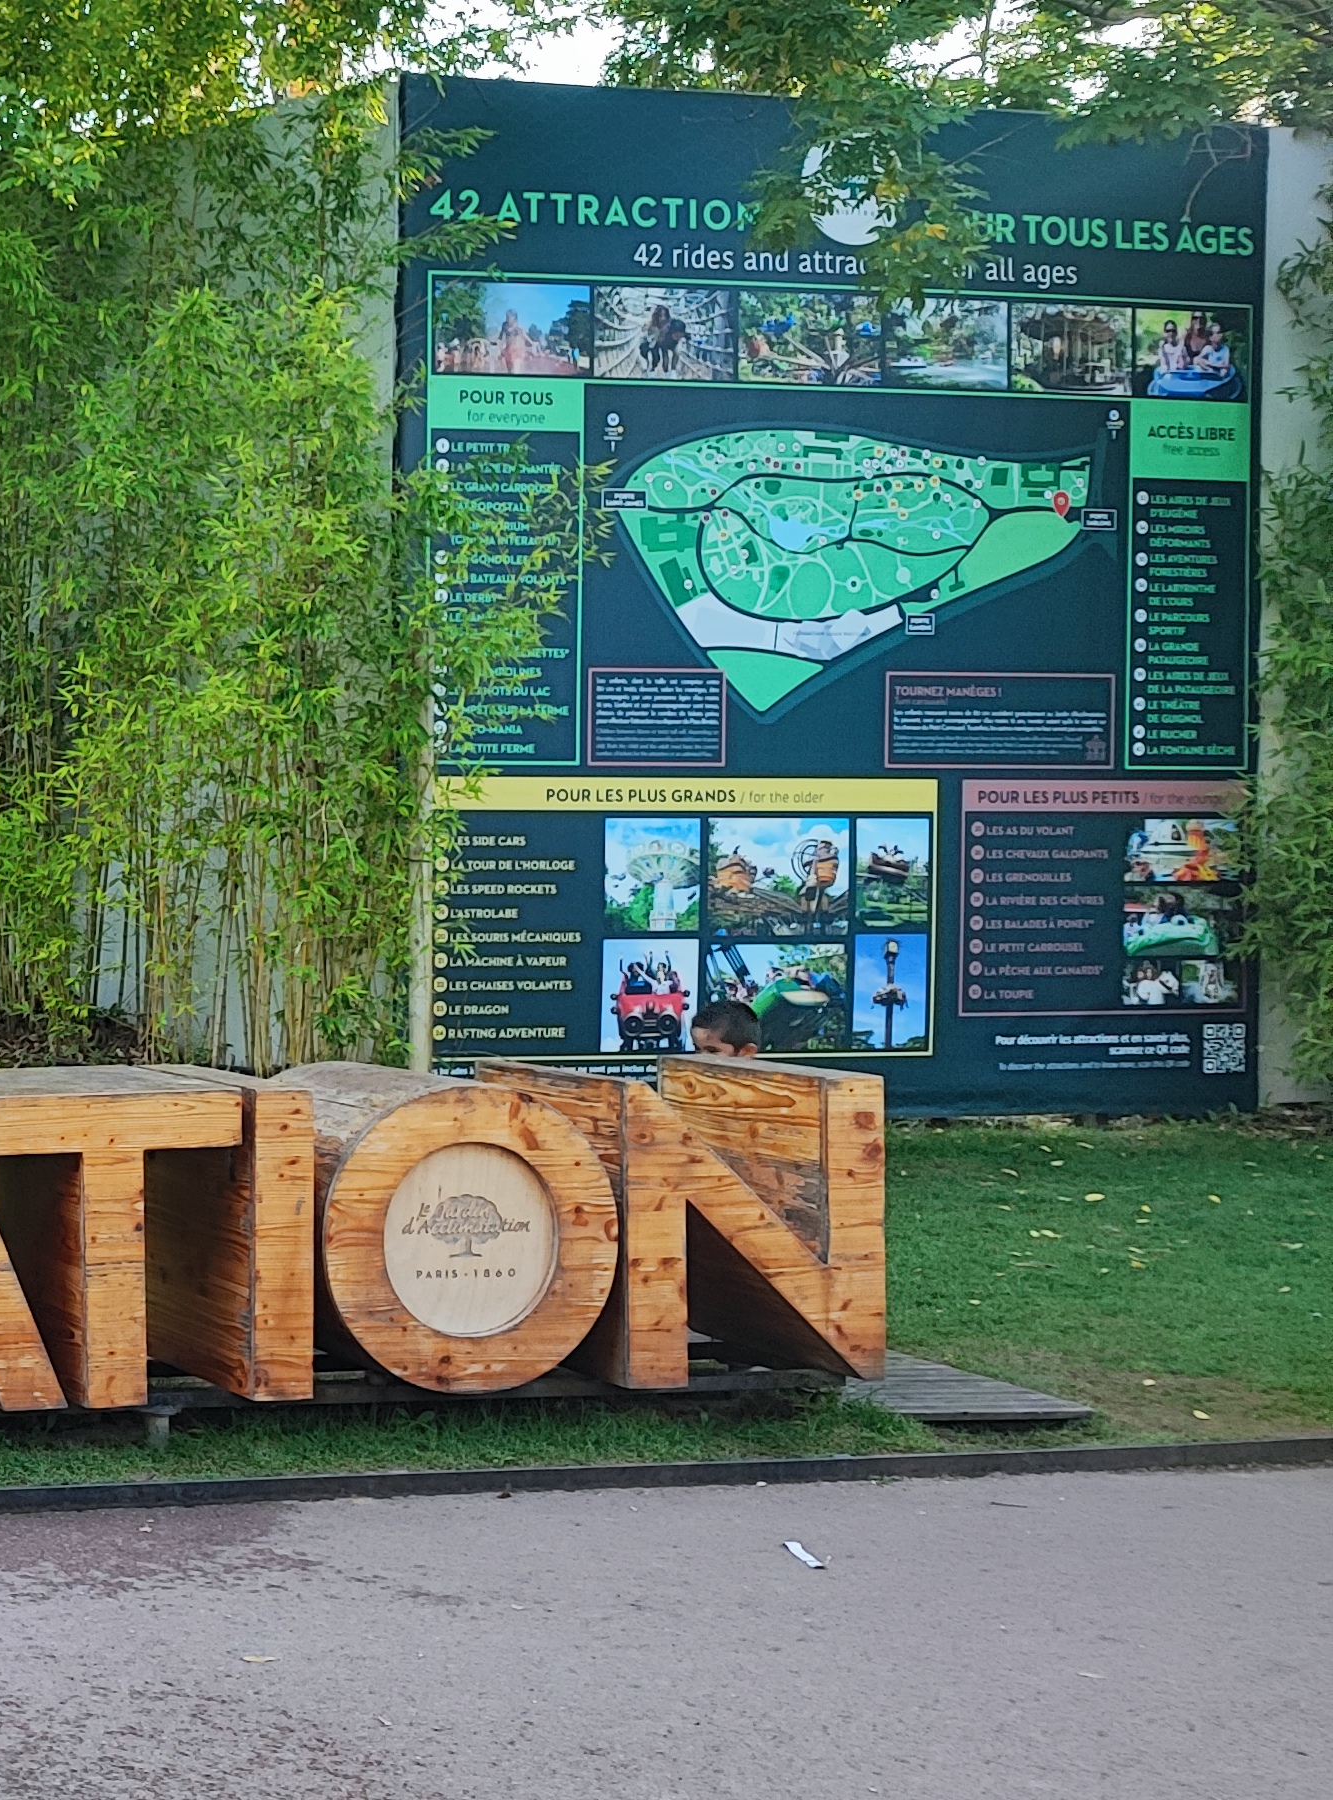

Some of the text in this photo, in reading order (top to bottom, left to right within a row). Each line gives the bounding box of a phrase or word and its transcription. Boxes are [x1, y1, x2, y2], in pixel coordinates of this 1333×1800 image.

[429, 188, 480, 220] 42
[496, 191, 765, 232] ATTRACTION
[1022, 214, 1108, 248] TOUS
[1115, 218, 1170, 251] LES
[1174, 216, 1255, 256] ÂGES
[633, 243, 663, 268] 42
[673, 243, 735, 270] rides
[742, 248, 790, 272] and
[984, 256, 1016, 282] all
[1022, 263, 1079, 289] ages
[459, 389, 555, 406] POUR TOUS
[466, 409, 546, 427] for everyone
[1147, 421, 1237, 441] ACCÈS LIBRE
[451, 442, 495, 453] LE PETIT
[529, 686, 551, 697] LAC
[893, 685, 944, 697] TOURNEZ
[945, 684, 997, 698] MANÈGES
[545, 788, 591, 802] POUR
[595, 788, 623, 803] LES
[627, 789, 667, 803] PLUS
[671, 789, 736, 803] GRANDS
[748, 790, 766, 804] for
[769, 790, 789, 804] the
[792, 791, 825, 804] older
[977, 790, 1020, 804] POUR
[1023, 790, 1050, 805] LES
[1052, 790, 1088, 805] PLUS
[1091, 791, 1140, 805] PETITS
[986, 826, 1004, 836] LES
[1035, 826, 1075, 836] VOLANT
[471, 835, 496, 847] SIDE
[498, 835, 527, 847] CARS
[986, 849, 1003, 859] LES
[1005, 849, 1050, 860] CHEVAUX
[466, 860, 497, 871] TOUR
[498, 860, 513, 871] DE
[985, 873, 1003, 882] LES
[450, 883, 558, 896] LES SPEED ROCKETS
[985, 896, 999, 906] LA
[985, 919, 1003, 929] LES
[471, 931, 510, 943] SOURIS
[511, 930, 582, 944] MÉCANIQUES
[984, 943, 997, 952] LE
[998, 943, 1026, 953] PETIT
[449, 956, 464, 968] LA
[525, 956, 568, 968] VAPEUR
[984, 966, 997, 976] LA
[448, 980, 574, 992] LES CHAISES VOLANTES
[984, 989, 1034, 1000] LA TOUPIE
[448, 1004, 510, 1016] LE DRAGON
[447, 1027, 497, 1039] RAFTING
[498, 1027, 566, 1039] ADVENTURE
[416, 1268, 516, 1279] PARIS 1860
